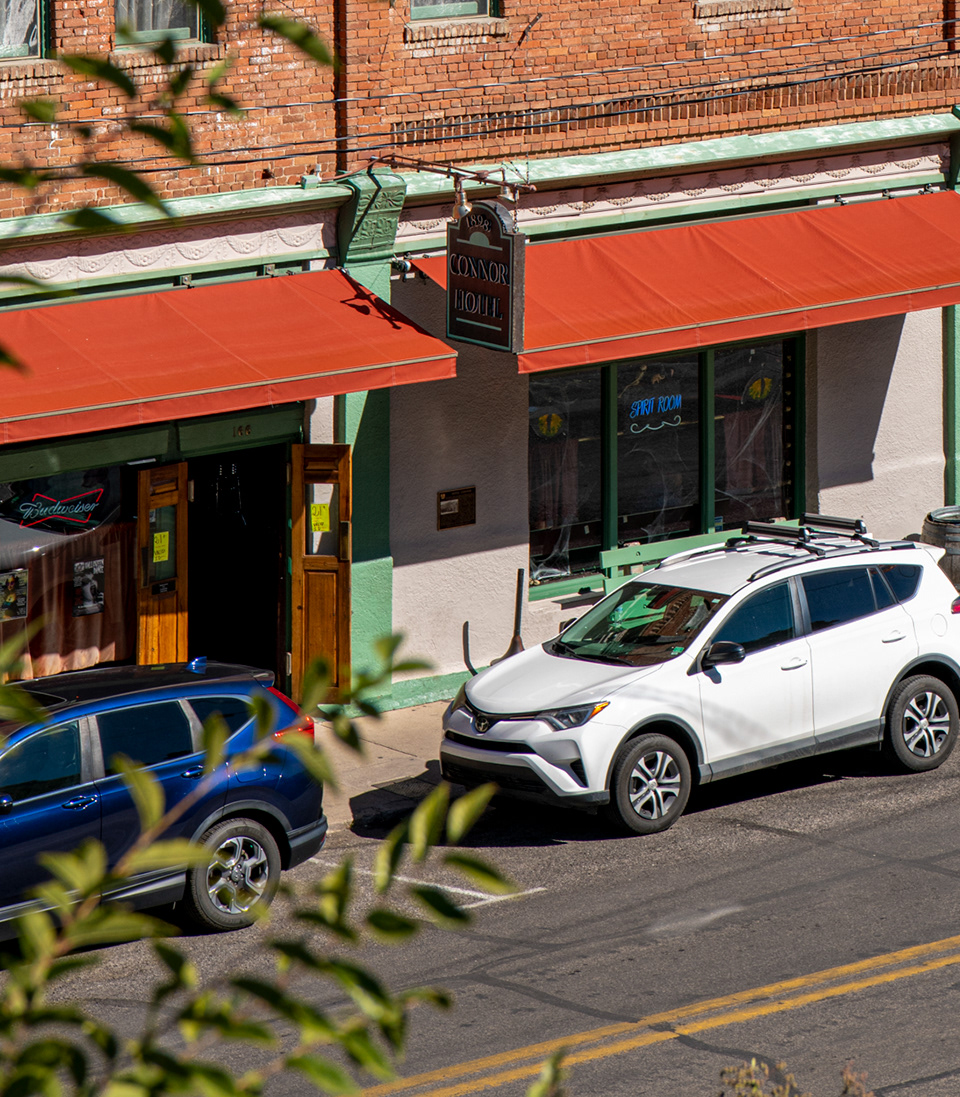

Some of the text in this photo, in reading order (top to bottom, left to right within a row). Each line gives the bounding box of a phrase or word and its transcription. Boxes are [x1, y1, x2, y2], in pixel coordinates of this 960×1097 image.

[465, 214, 492, 233] 1898
[449, 253, 510, 287] CONNOR
[454, 288, 503, 320] HOTEL
[657, 394, 682, 413] ROOM
[232, 424, 252, 438] 166
[20, 501, 99, 519] Budweiser
